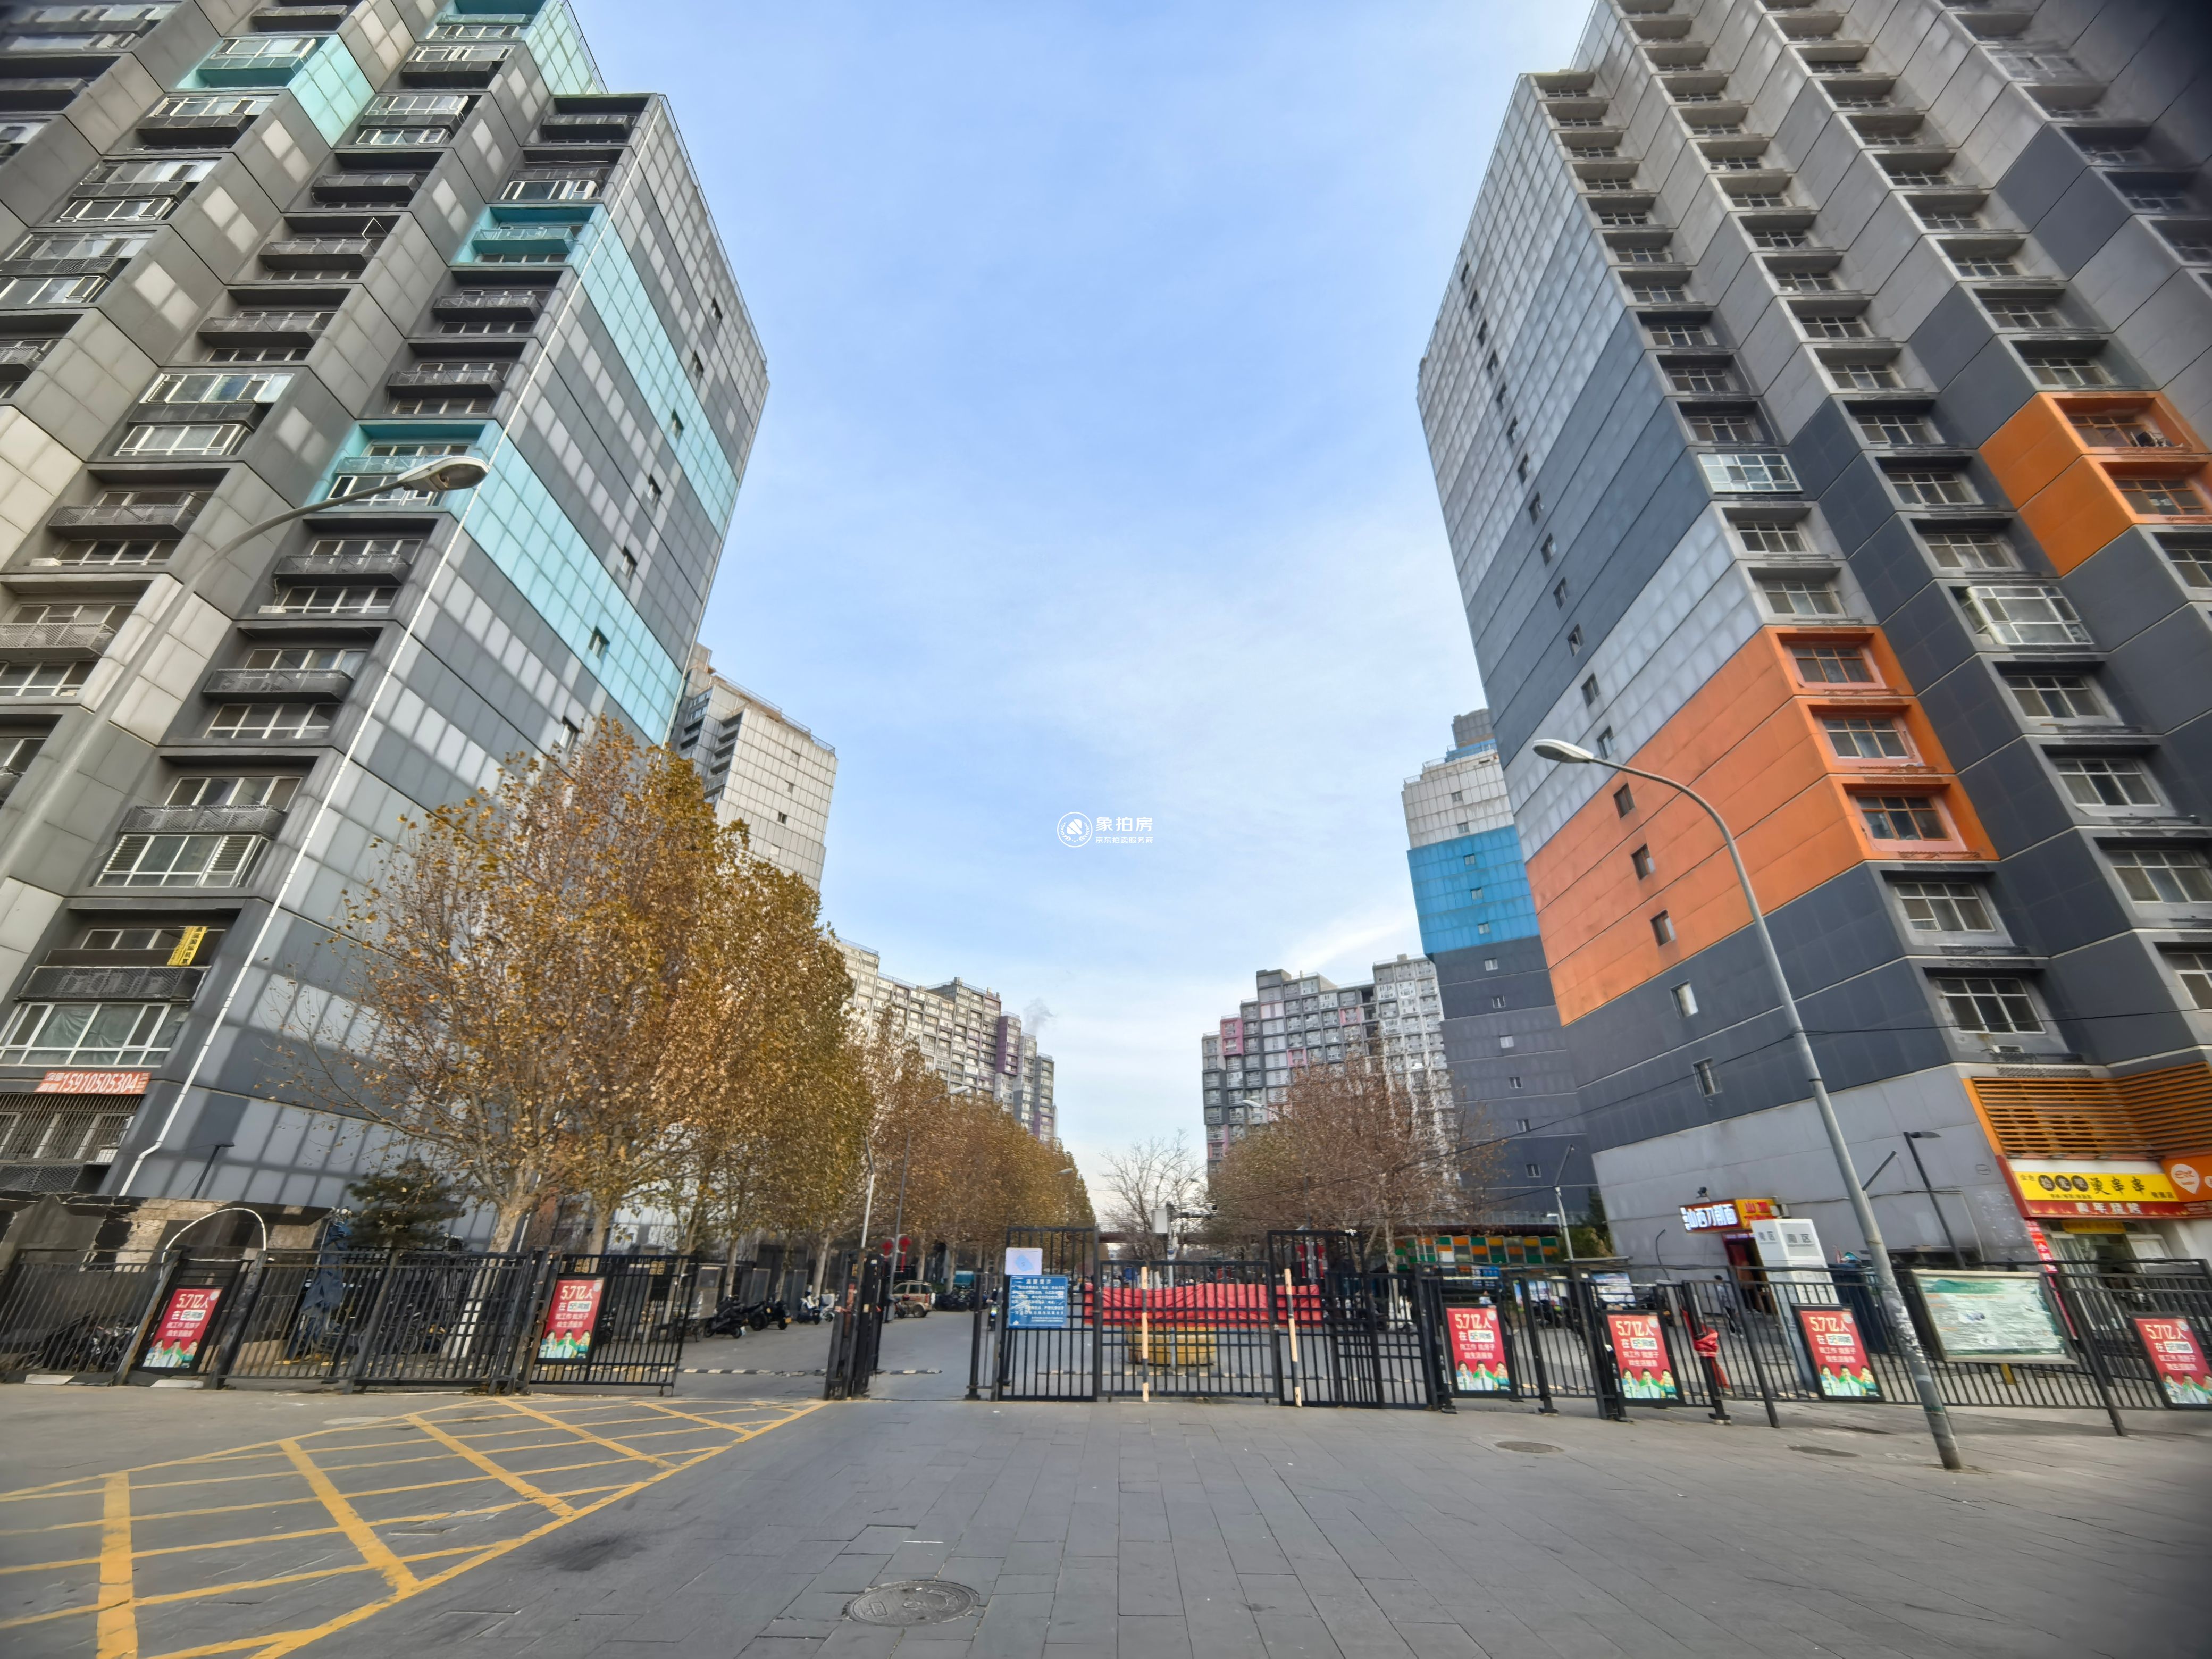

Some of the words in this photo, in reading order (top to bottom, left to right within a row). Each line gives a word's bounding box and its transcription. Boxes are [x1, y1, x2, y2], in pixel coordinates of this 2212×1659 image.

[58, 1073, 140, 1093] 15910505304
[560, 1286, 593, 1300] 5.7亿人
[1455, 1314, 1493, 1329] 5.7亿人
[1615, 1321, 1654, 1336] 5.7亿人
[1809, 1317, 1850, 1332] 5.7亿人
[2144, 1325, 2189, 1339] 5.7亿人
